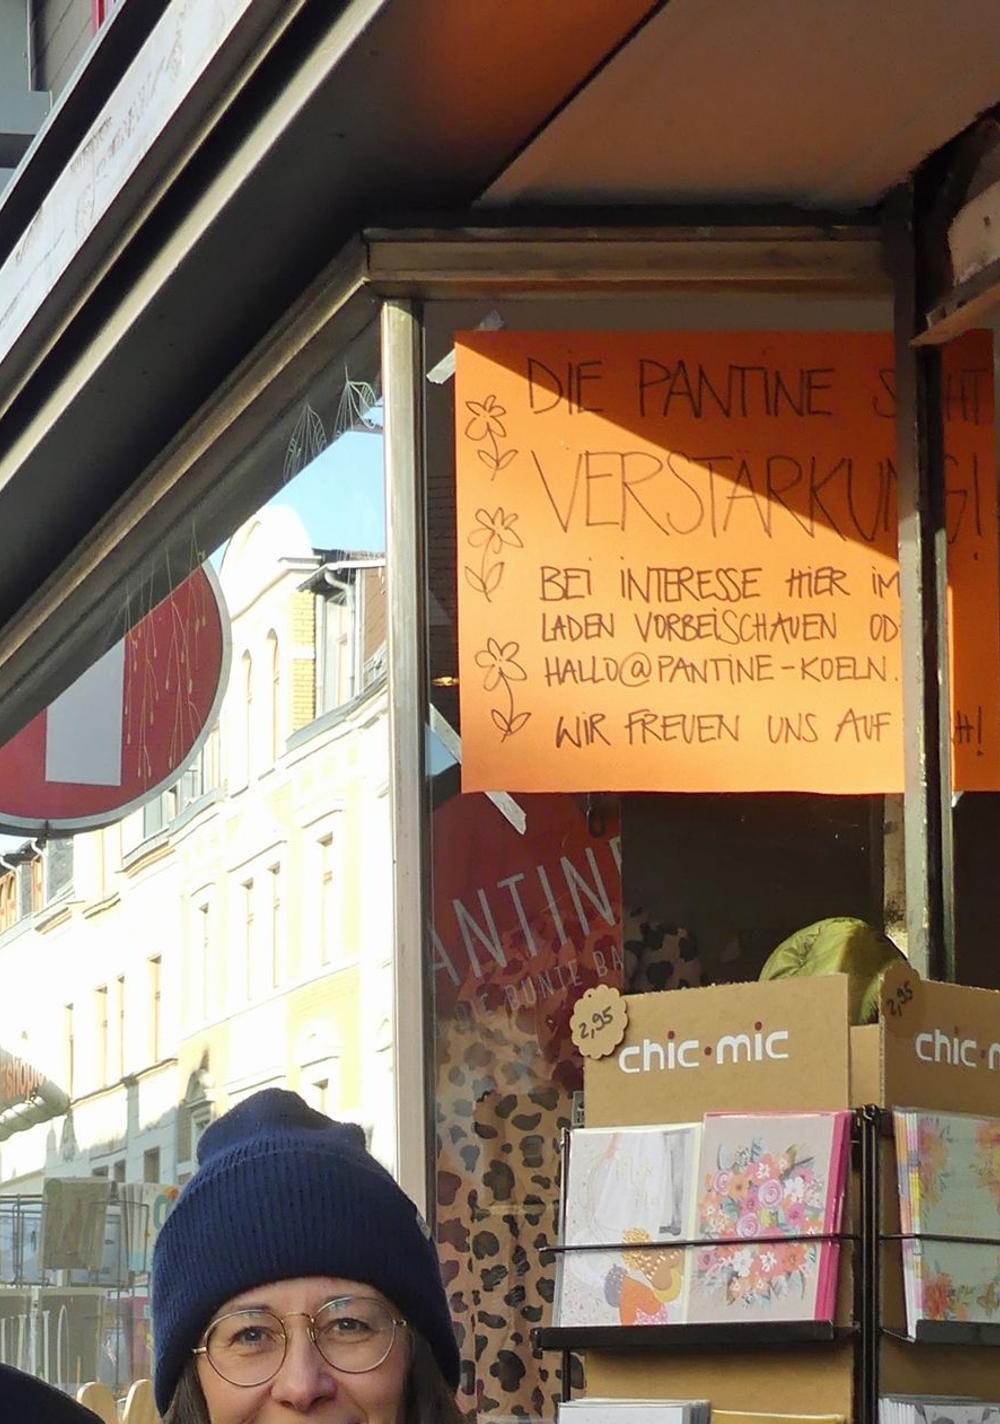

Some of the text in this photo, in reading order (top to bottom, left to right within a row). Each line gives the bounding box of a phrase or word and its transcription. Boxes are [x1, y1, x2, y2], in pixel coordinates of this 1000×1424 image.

[527, 350, 990, 426] DIE PANTINE SHT
[539, 556, 594, 601] BEI
[619, 556, 763, 603] INTERESSE
[785, 566, 851, 599] HIER
[541, 607, 901, 645] LADEN VORBEISCHAUEN OD
[544, 650, 899, 688] HALLO@PANTINE-KOELN.
[555, 707, 892, 749] WIR FREUEN UNS AUF
[425, 836, 623, 987] ANTIN
[886, 979, 915, 1018] 2,95
[578, 1005, 614, 1040] 2,95
